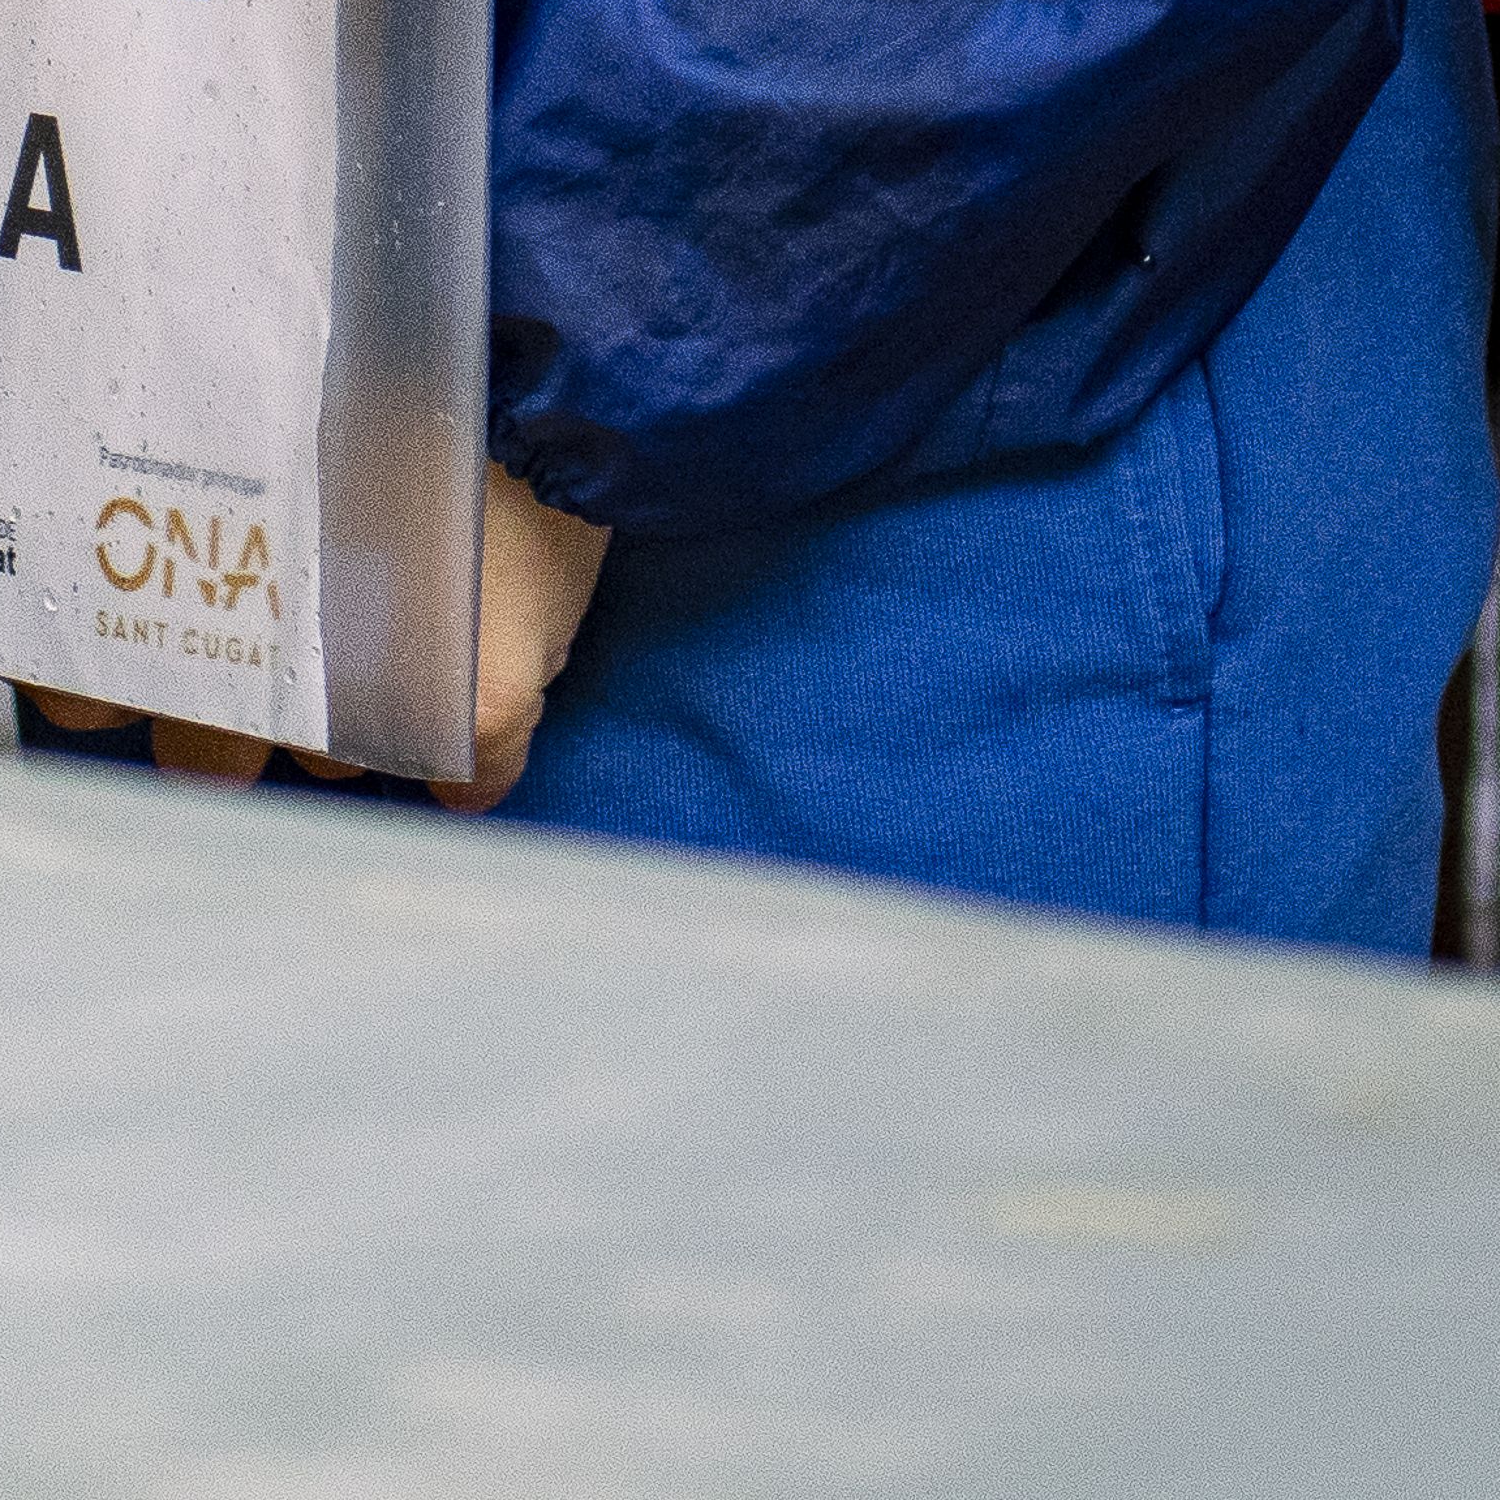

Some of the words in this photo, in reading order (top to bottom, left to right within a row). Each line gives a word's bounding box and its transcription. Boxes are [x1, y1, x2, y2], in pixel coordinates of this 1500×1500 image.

[94, 496, 283, 622] ONA
[94, 608, 169, 649] SANT
[179, 625, 281, 670] CUGAT
